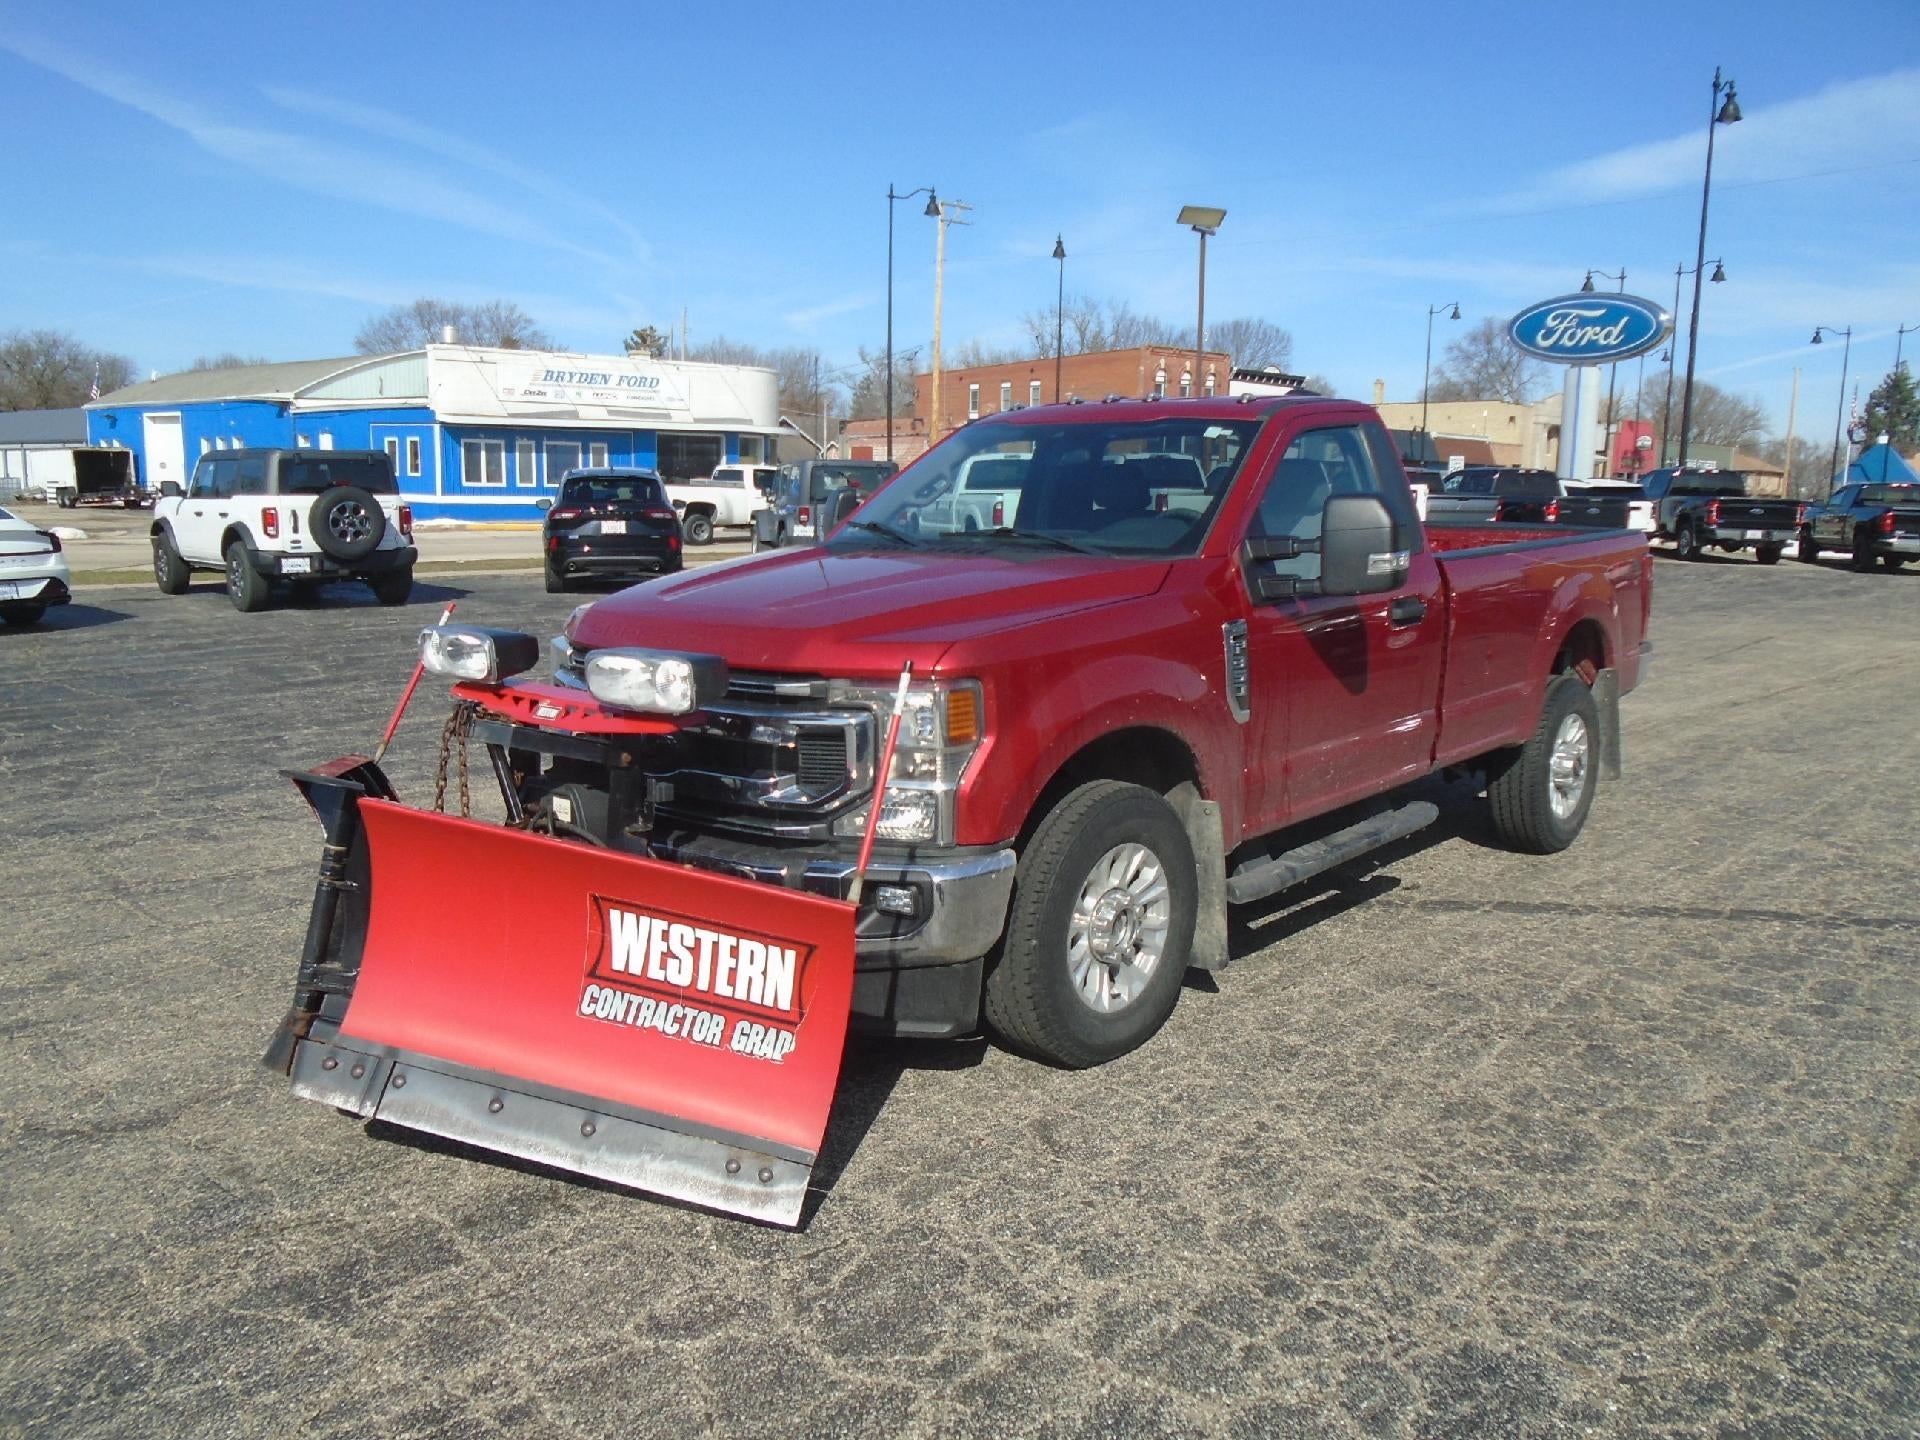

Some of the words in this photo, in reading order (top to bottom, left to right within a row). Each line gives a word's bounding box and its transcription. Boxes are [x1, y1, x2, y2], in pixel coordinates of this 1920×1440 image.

[1536, 308, 1630, 348] Ford
[542, 369, 611, 386] BRYDEN
[616, 375, 660, 389] FORD
[609, 908, 797, 1011] WESTERN
[580, 984, 726, 1046] CONTRACTOR
